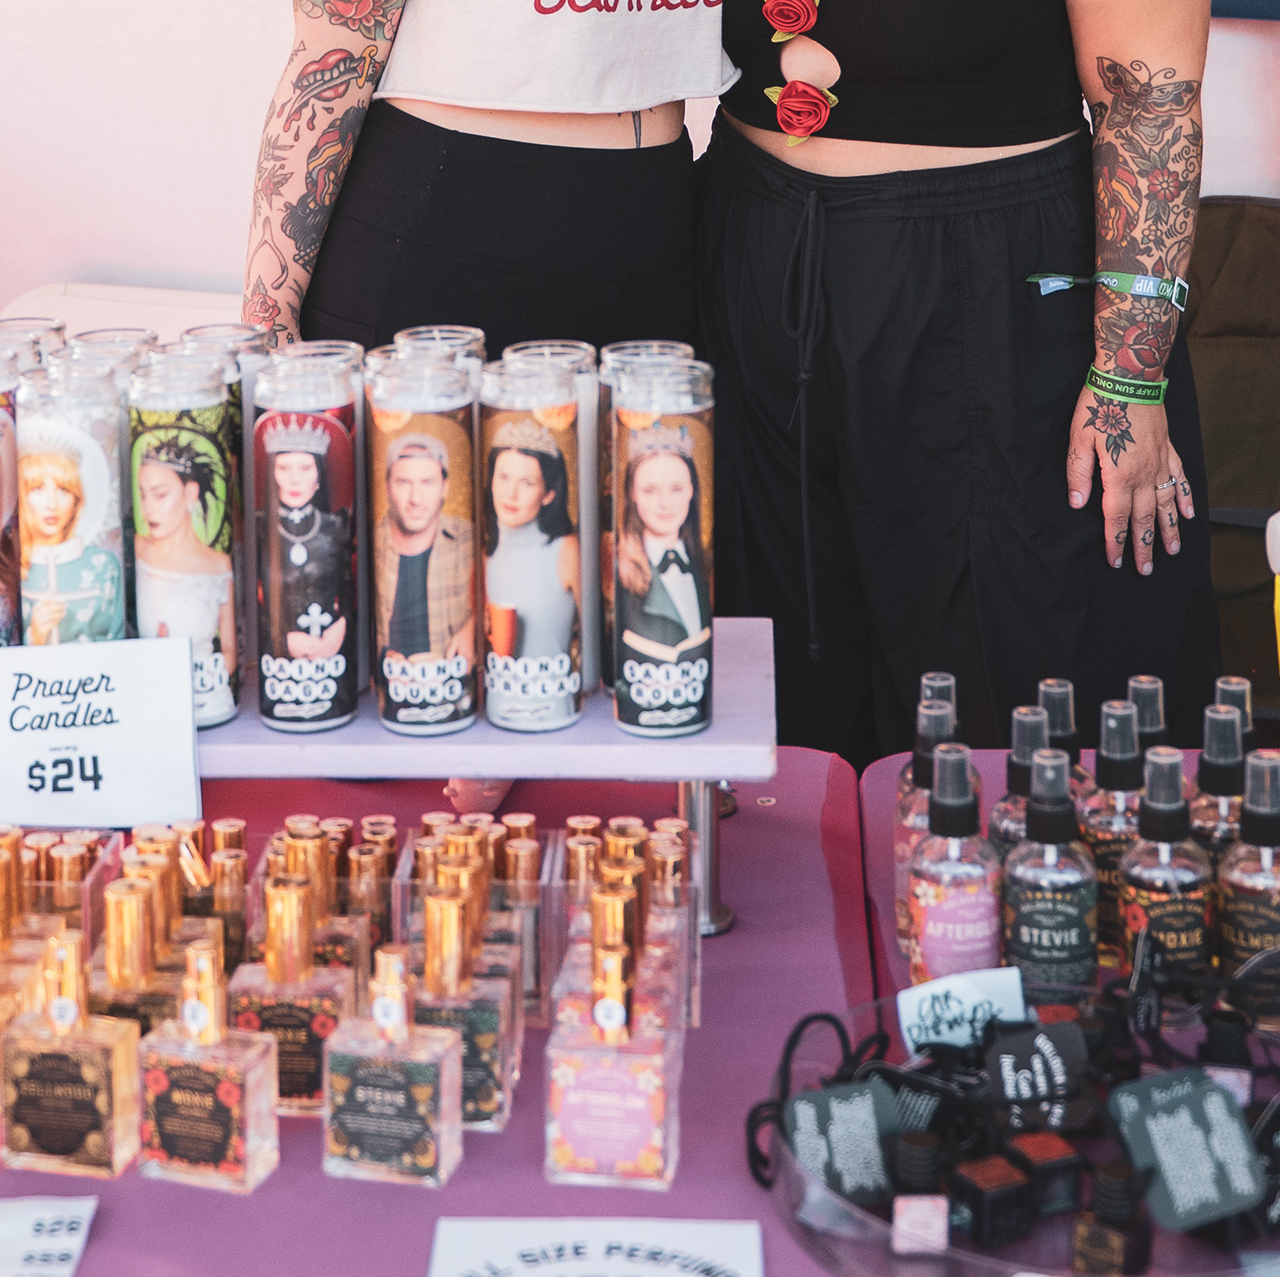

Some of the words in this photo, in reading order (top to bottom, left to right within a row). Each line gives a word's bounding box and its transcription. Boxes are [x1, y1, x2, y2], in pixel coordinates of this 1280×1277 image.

[1135, 279, 1154, 293] VIP
[1091, 375, 1114, 389] ONLY
[1115, 384, 1134, 394] SUN
[1136, 388, 1160, 396] STAFF
[264, 659, 341, 676] SAINT
[387, 660, 462, 677] SAINT
[490, 655, 564, 673] SAINT
[630, 665, 704, 681] SAINT
[12, 673, 115, 704] Prayer
[393, 682, 459, 699] LUKE
[10, 702, 120, 732] Candles
[28, 755, 102, 792] $24
[1020, 925, 1081, 946] STEVIE
[518, 1241, 588, 1268] SIZE
